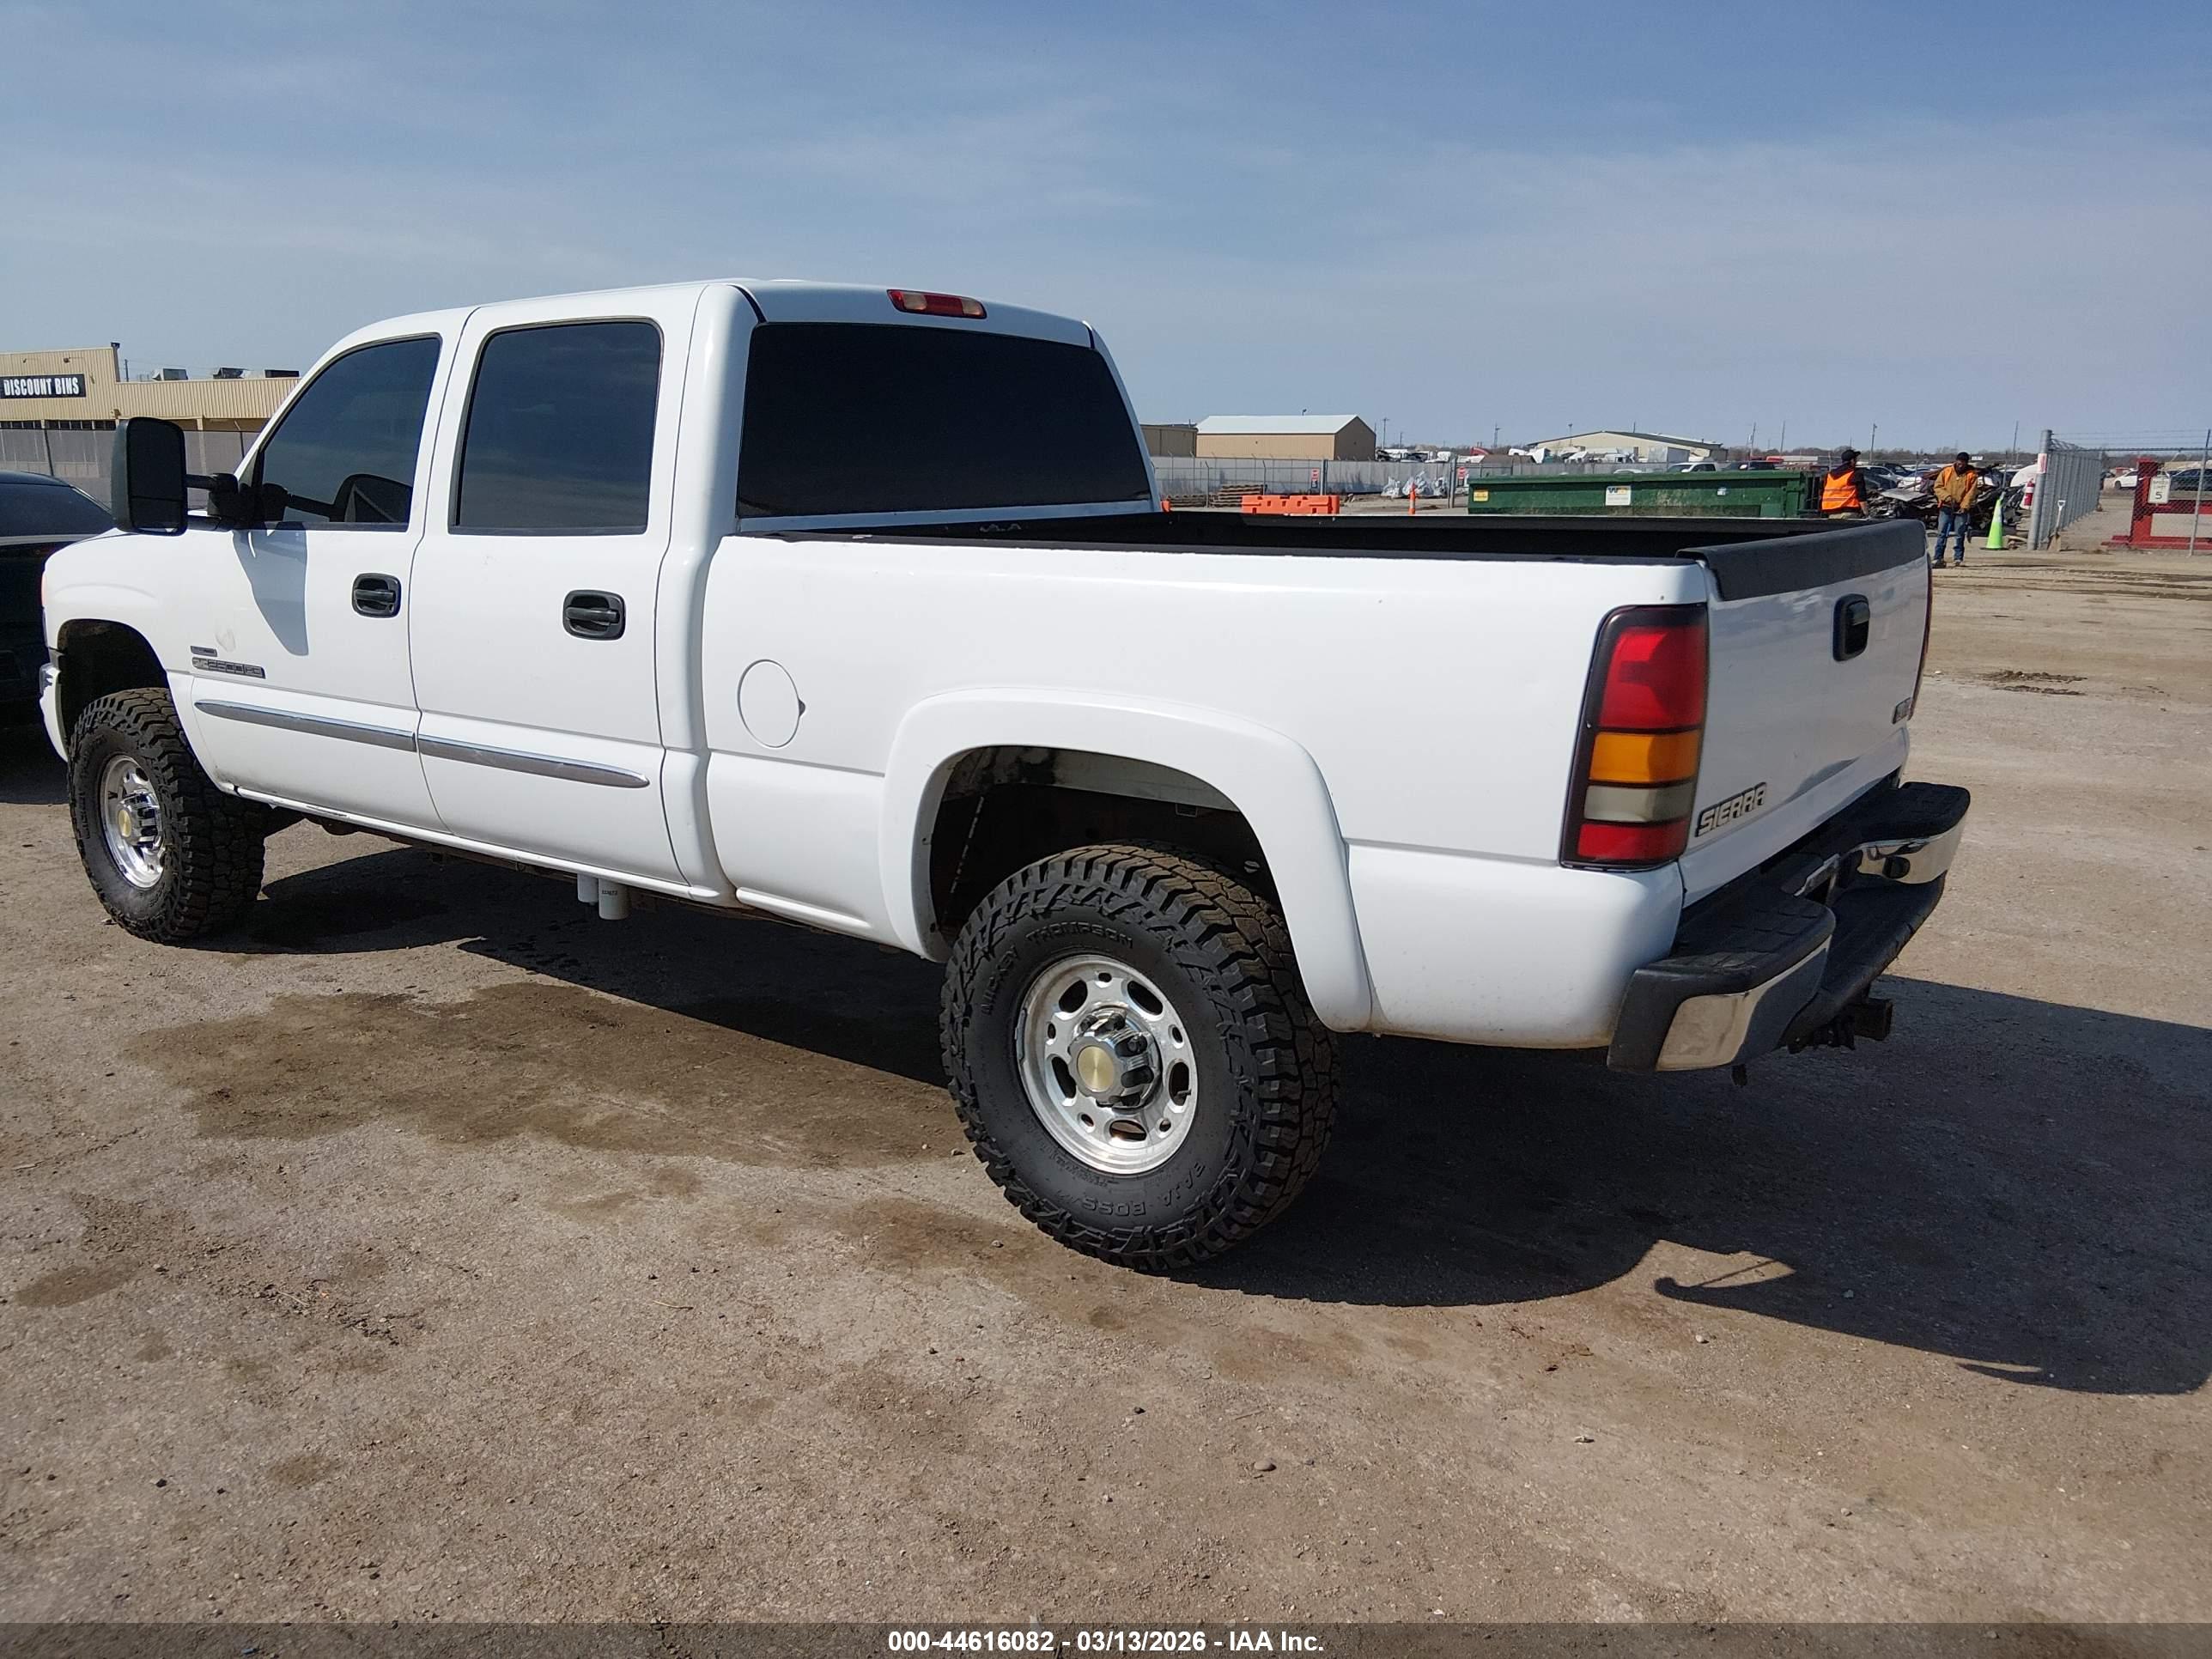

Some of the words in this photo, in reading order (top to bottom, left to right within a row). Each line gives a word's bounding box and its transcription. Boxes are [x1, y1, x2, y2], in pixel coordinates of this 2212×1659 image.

[3, 378, 52, 396] DISCOUNT
[54, 376, 80, 395] BINS
[1695, 782, 1766, 837] SIERRA
[1025, 921, 1133, 949] THOMPSON
